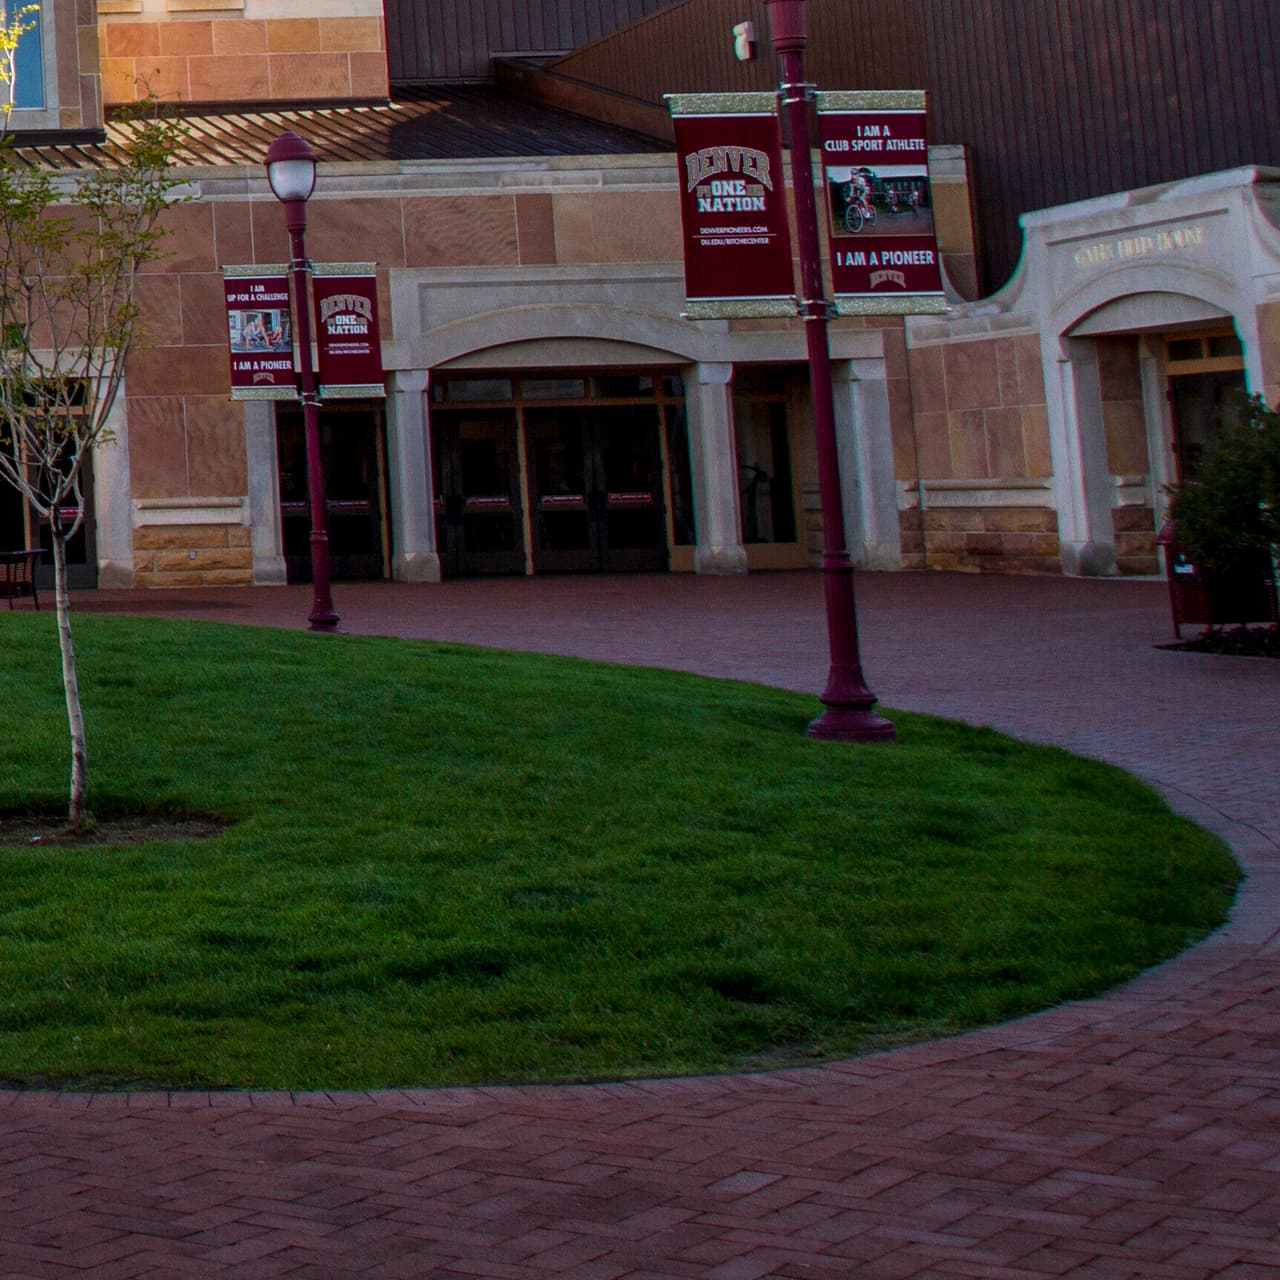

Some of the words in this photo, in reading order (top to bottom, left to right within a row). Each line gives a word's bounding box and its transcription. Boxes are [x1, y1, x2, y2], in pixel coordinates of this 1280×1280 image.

[857, 126, 861, 137] I
[863, 125, 880, 137] AM
[883, 125, 890, 136] A
[825, 140, 849, 151] CLUB
[851, 140, 883, 151] SPORT
[886, 139, 925, 151] ATHLETE
[685, 145, 773, 192] DENVER
[711, 180, 746, 196] ONE
[698, 197, 766, 212] NATION
[837, 253, 841, 266] I
[845, 252, 866, 266] AM
[869, 252, 879, 265] A
[881, 250, 934, 265] PIONEER
[870, 270, 906, 289] DENVER
[227, 294, 236, 302] UP
[237, 294, 249, 302] FOR
[256, 293, 288, 301] CHALLENGE
[320, 294, 373, 323] DENVER
[328, 325, 368, 334] NATION
[233, 362, 237, 370] I
[239, 361, 251, 370] AM
[253, 361, 259, 370] A
[261, 360, 292, 369] PIONEER
